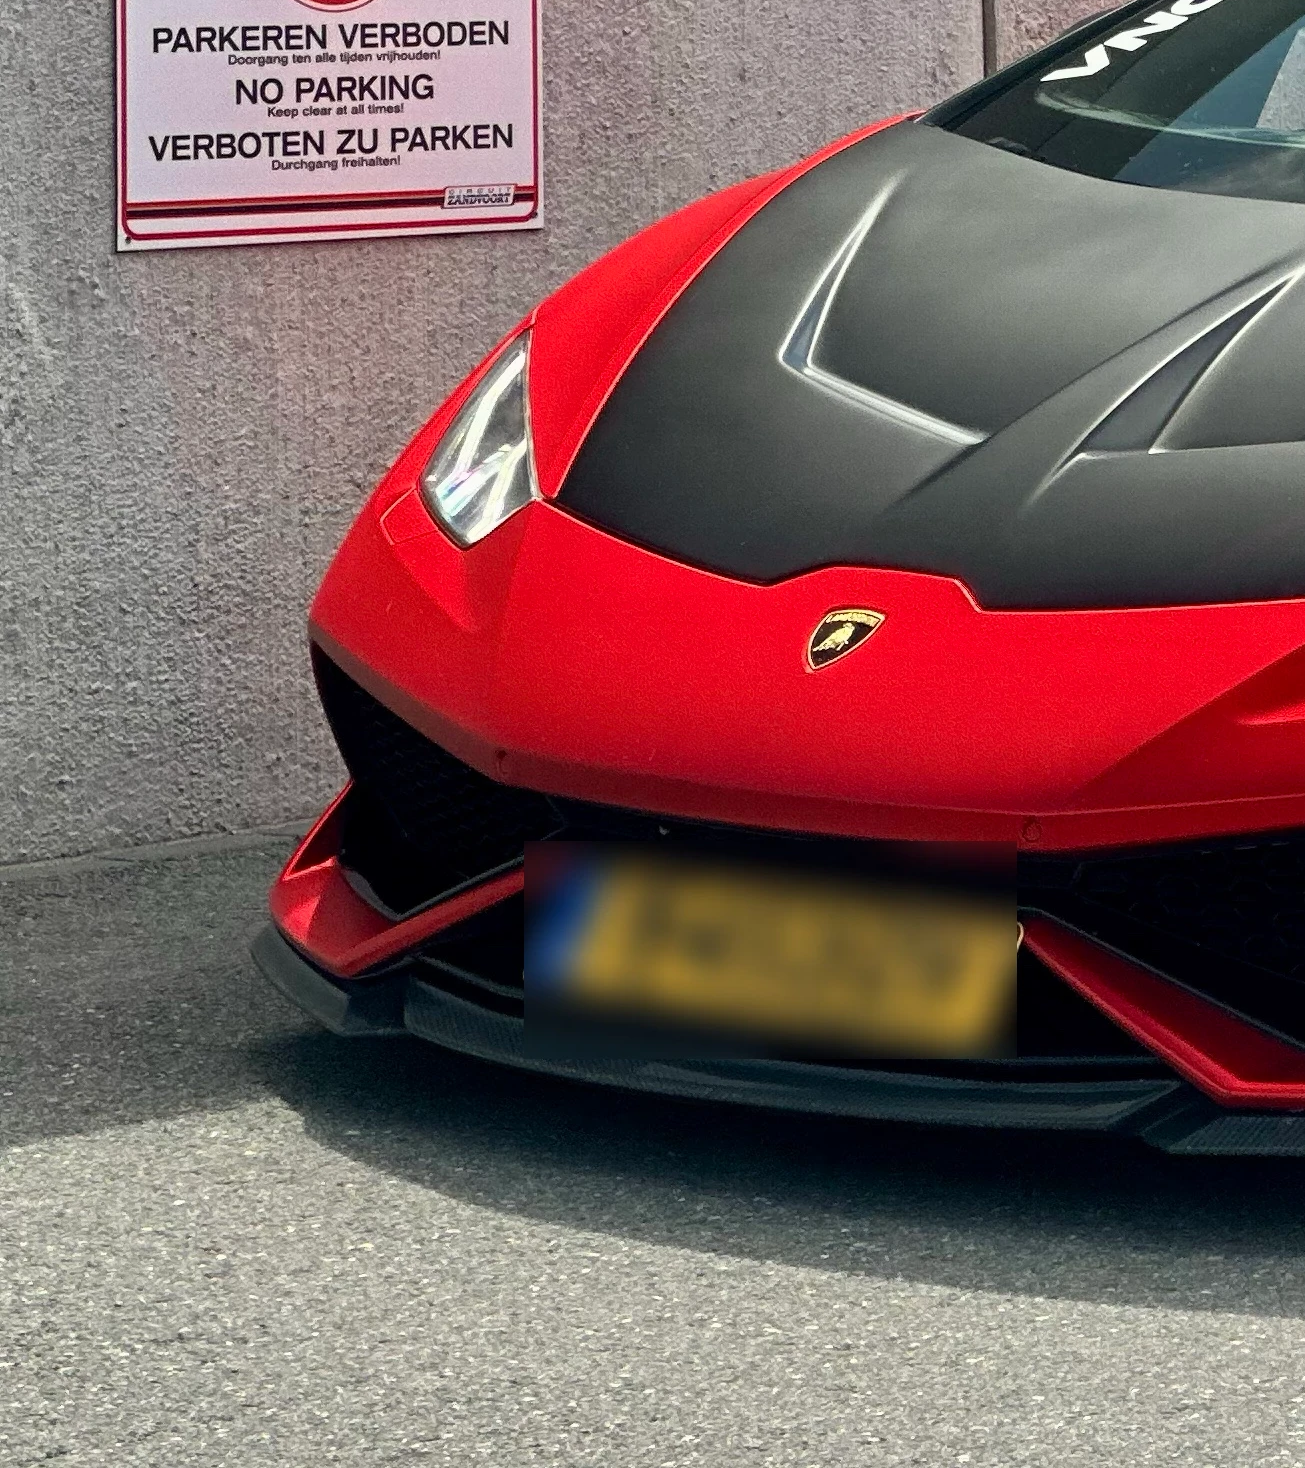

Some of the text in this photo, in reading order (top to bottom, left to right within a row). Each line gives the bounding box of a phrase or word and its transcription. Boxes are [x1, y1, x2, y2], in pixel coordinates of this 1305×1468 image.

[152, 20, 509, 53] PARKEREN VERBODEN
[228, 49, 441, 67] Doorgang ten alle tijden vrijhouden!
[235, 74, 434, 105] NO PARKING
[267, 103, 405, 119] Keep clear at all times!
[148, 123, 513, 161] VERBOTEN ZU PARKEN
[271, 155, 401, 171] Durchgang freihalten!
